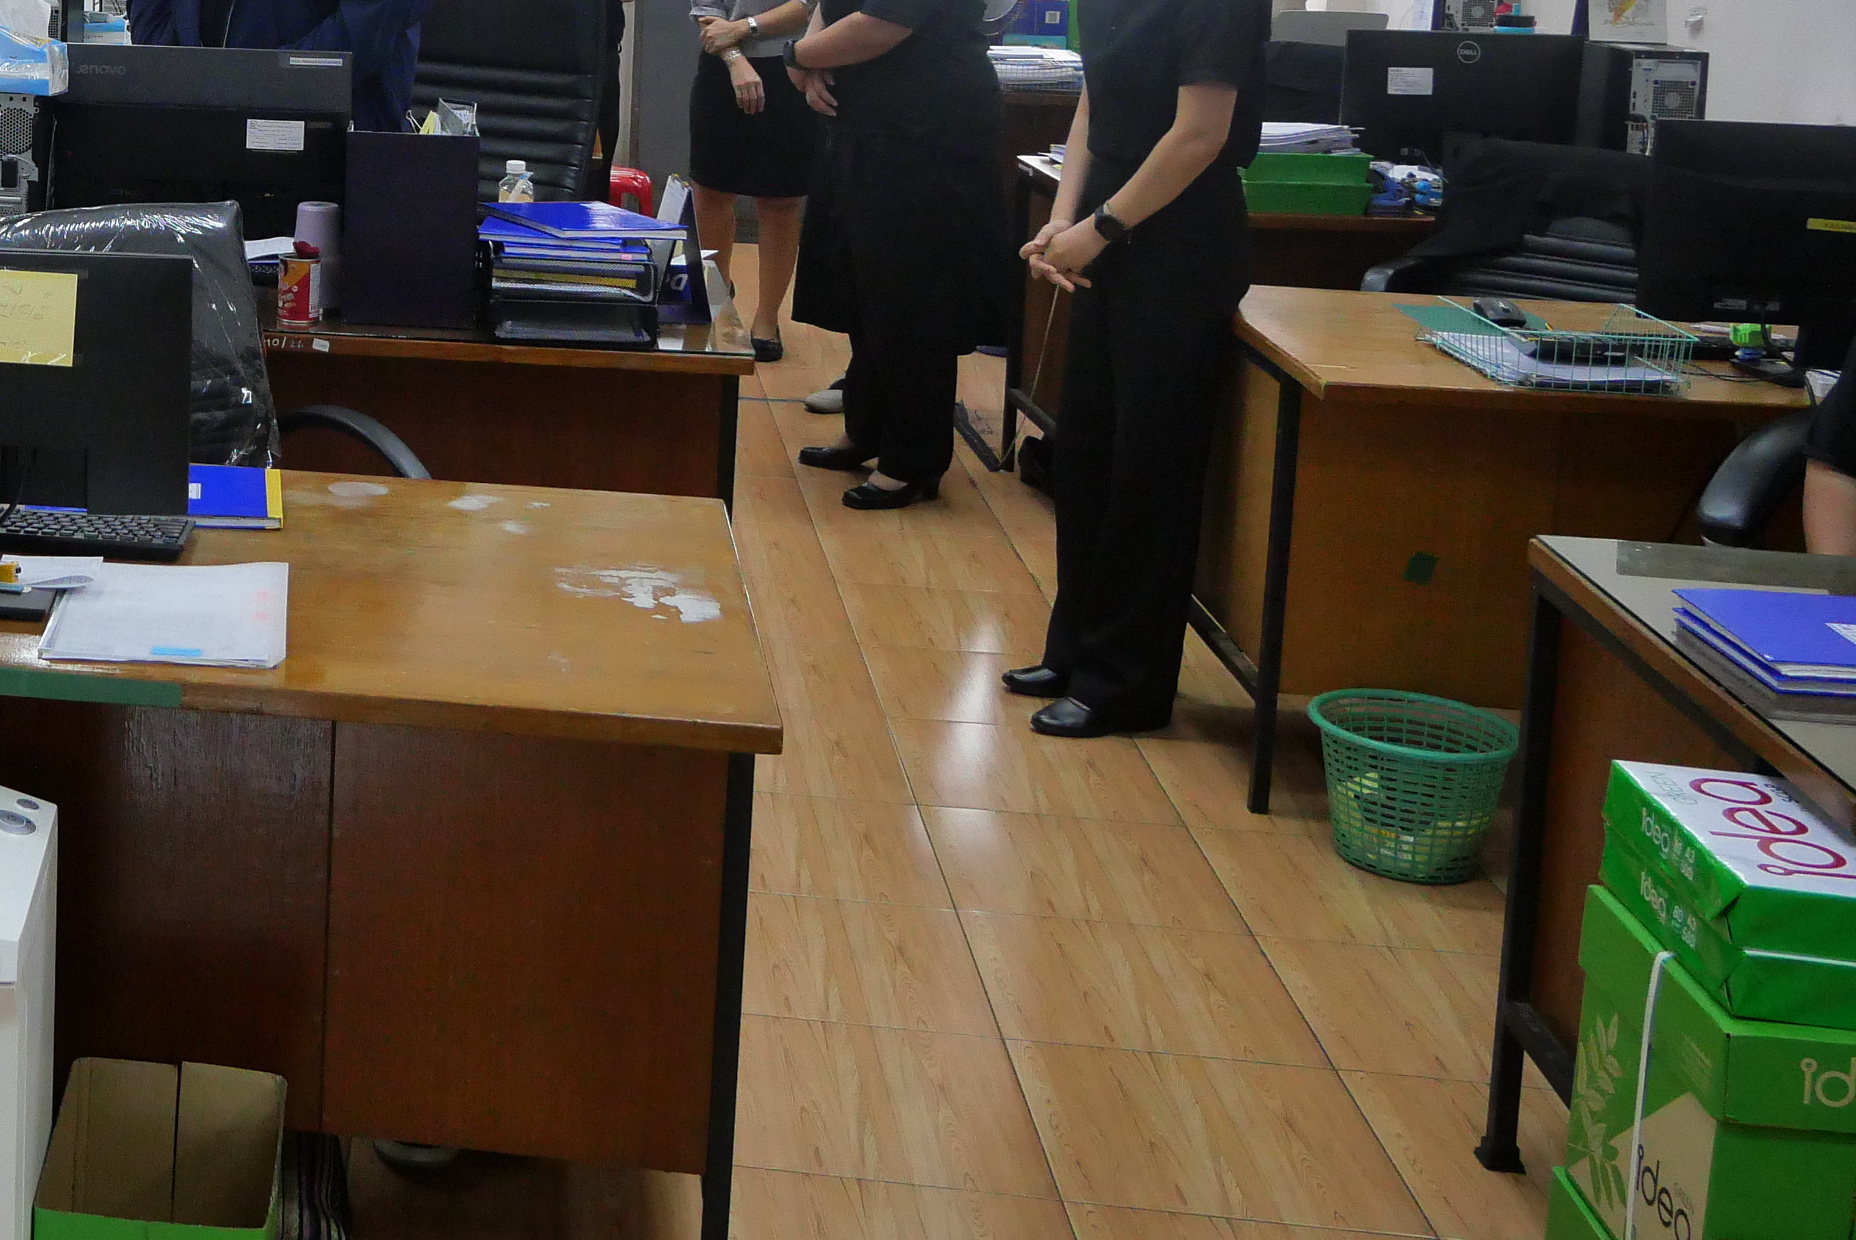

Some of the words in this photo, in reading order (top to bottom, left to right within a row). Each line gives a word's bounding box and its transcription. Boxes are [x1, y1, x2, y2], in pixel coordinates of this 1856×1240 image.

[1641, 807, 1669, 853] idea
[1689, 777, 1856, 880] idea
[1800, 1056, 1856, 1108] id
[1636, 1144, 1691, 1240] idea
